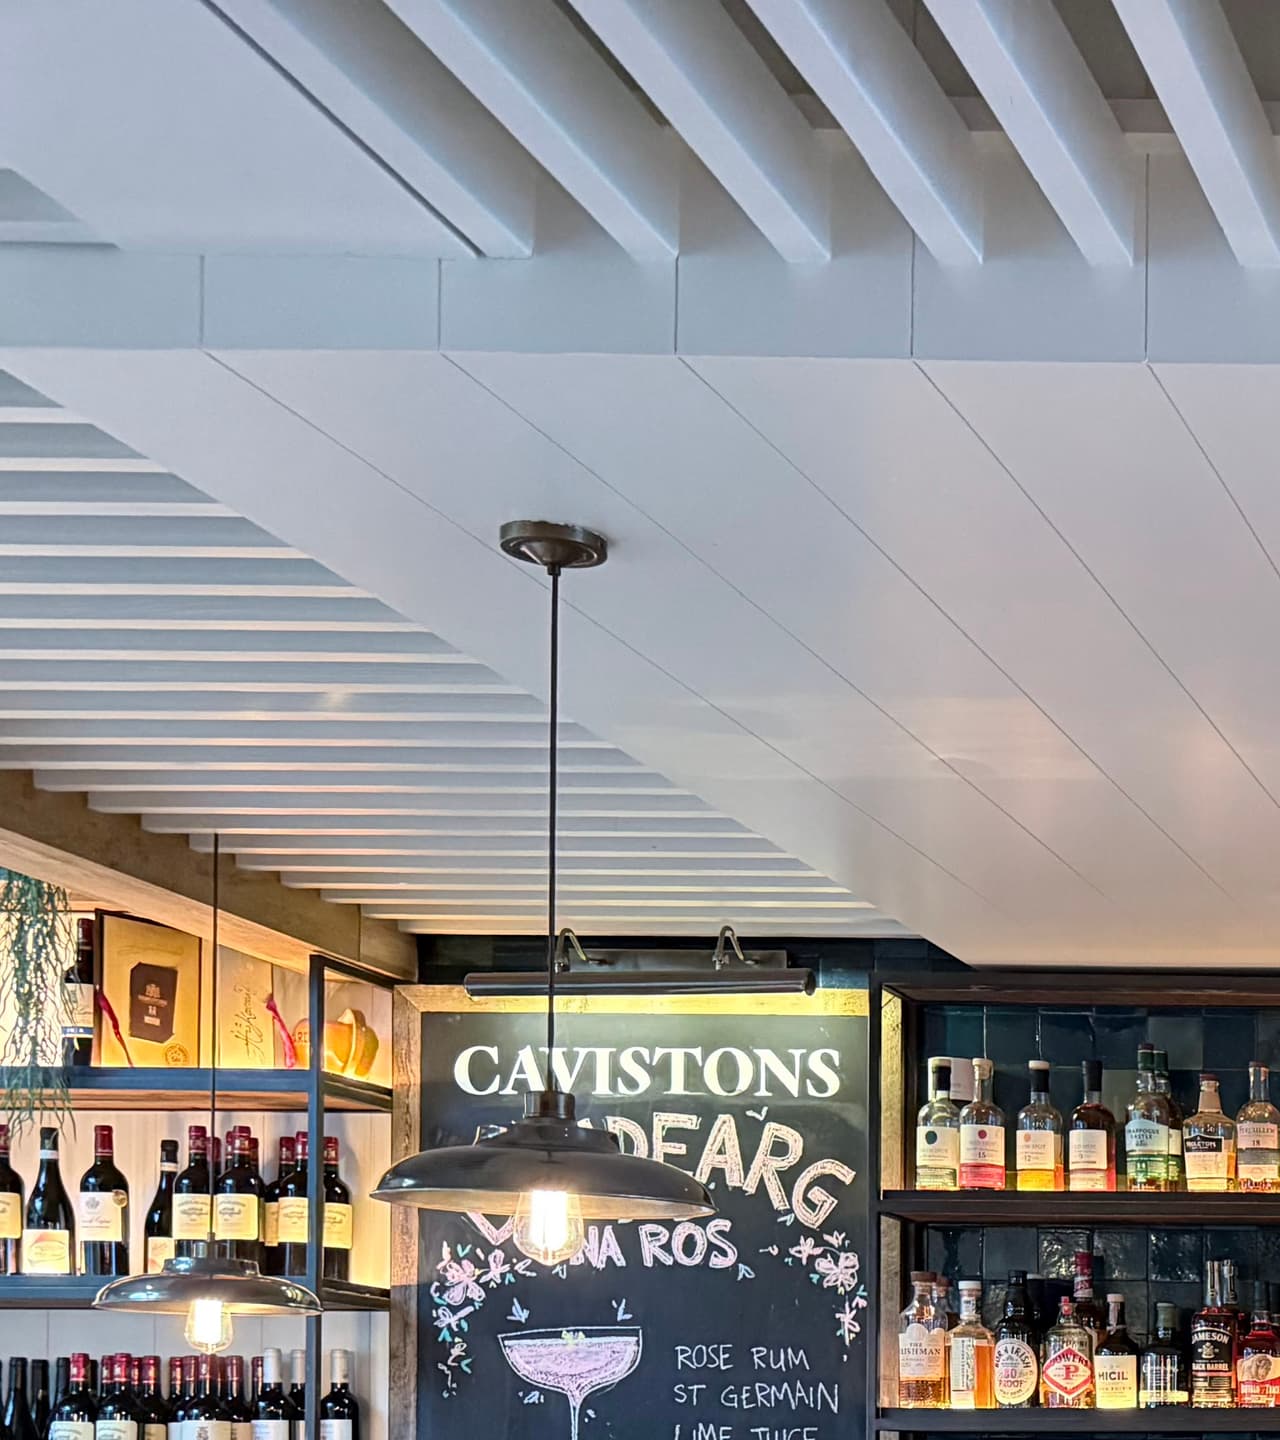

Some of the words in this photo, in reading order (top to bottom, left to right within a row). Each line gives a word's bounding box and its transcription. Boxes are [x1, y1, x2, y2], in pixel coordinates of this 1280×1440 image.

[453, 1044, 841, 1098] CAVISTONS
[638, 1218, 739, 1268] ROS
[1192, 1331, 1230, 1345] JAMESON
[674, 1344, 734, 1370] ROSE
[750, 1346, 810, 1372] RUM
[1050, 1354, 1089, 1366] POWERS
[1062, 1364, 1080, 1381] P
[673, 1384, 707, 1405] ST
[720, 1379, 839, 1414] GERMAIN
